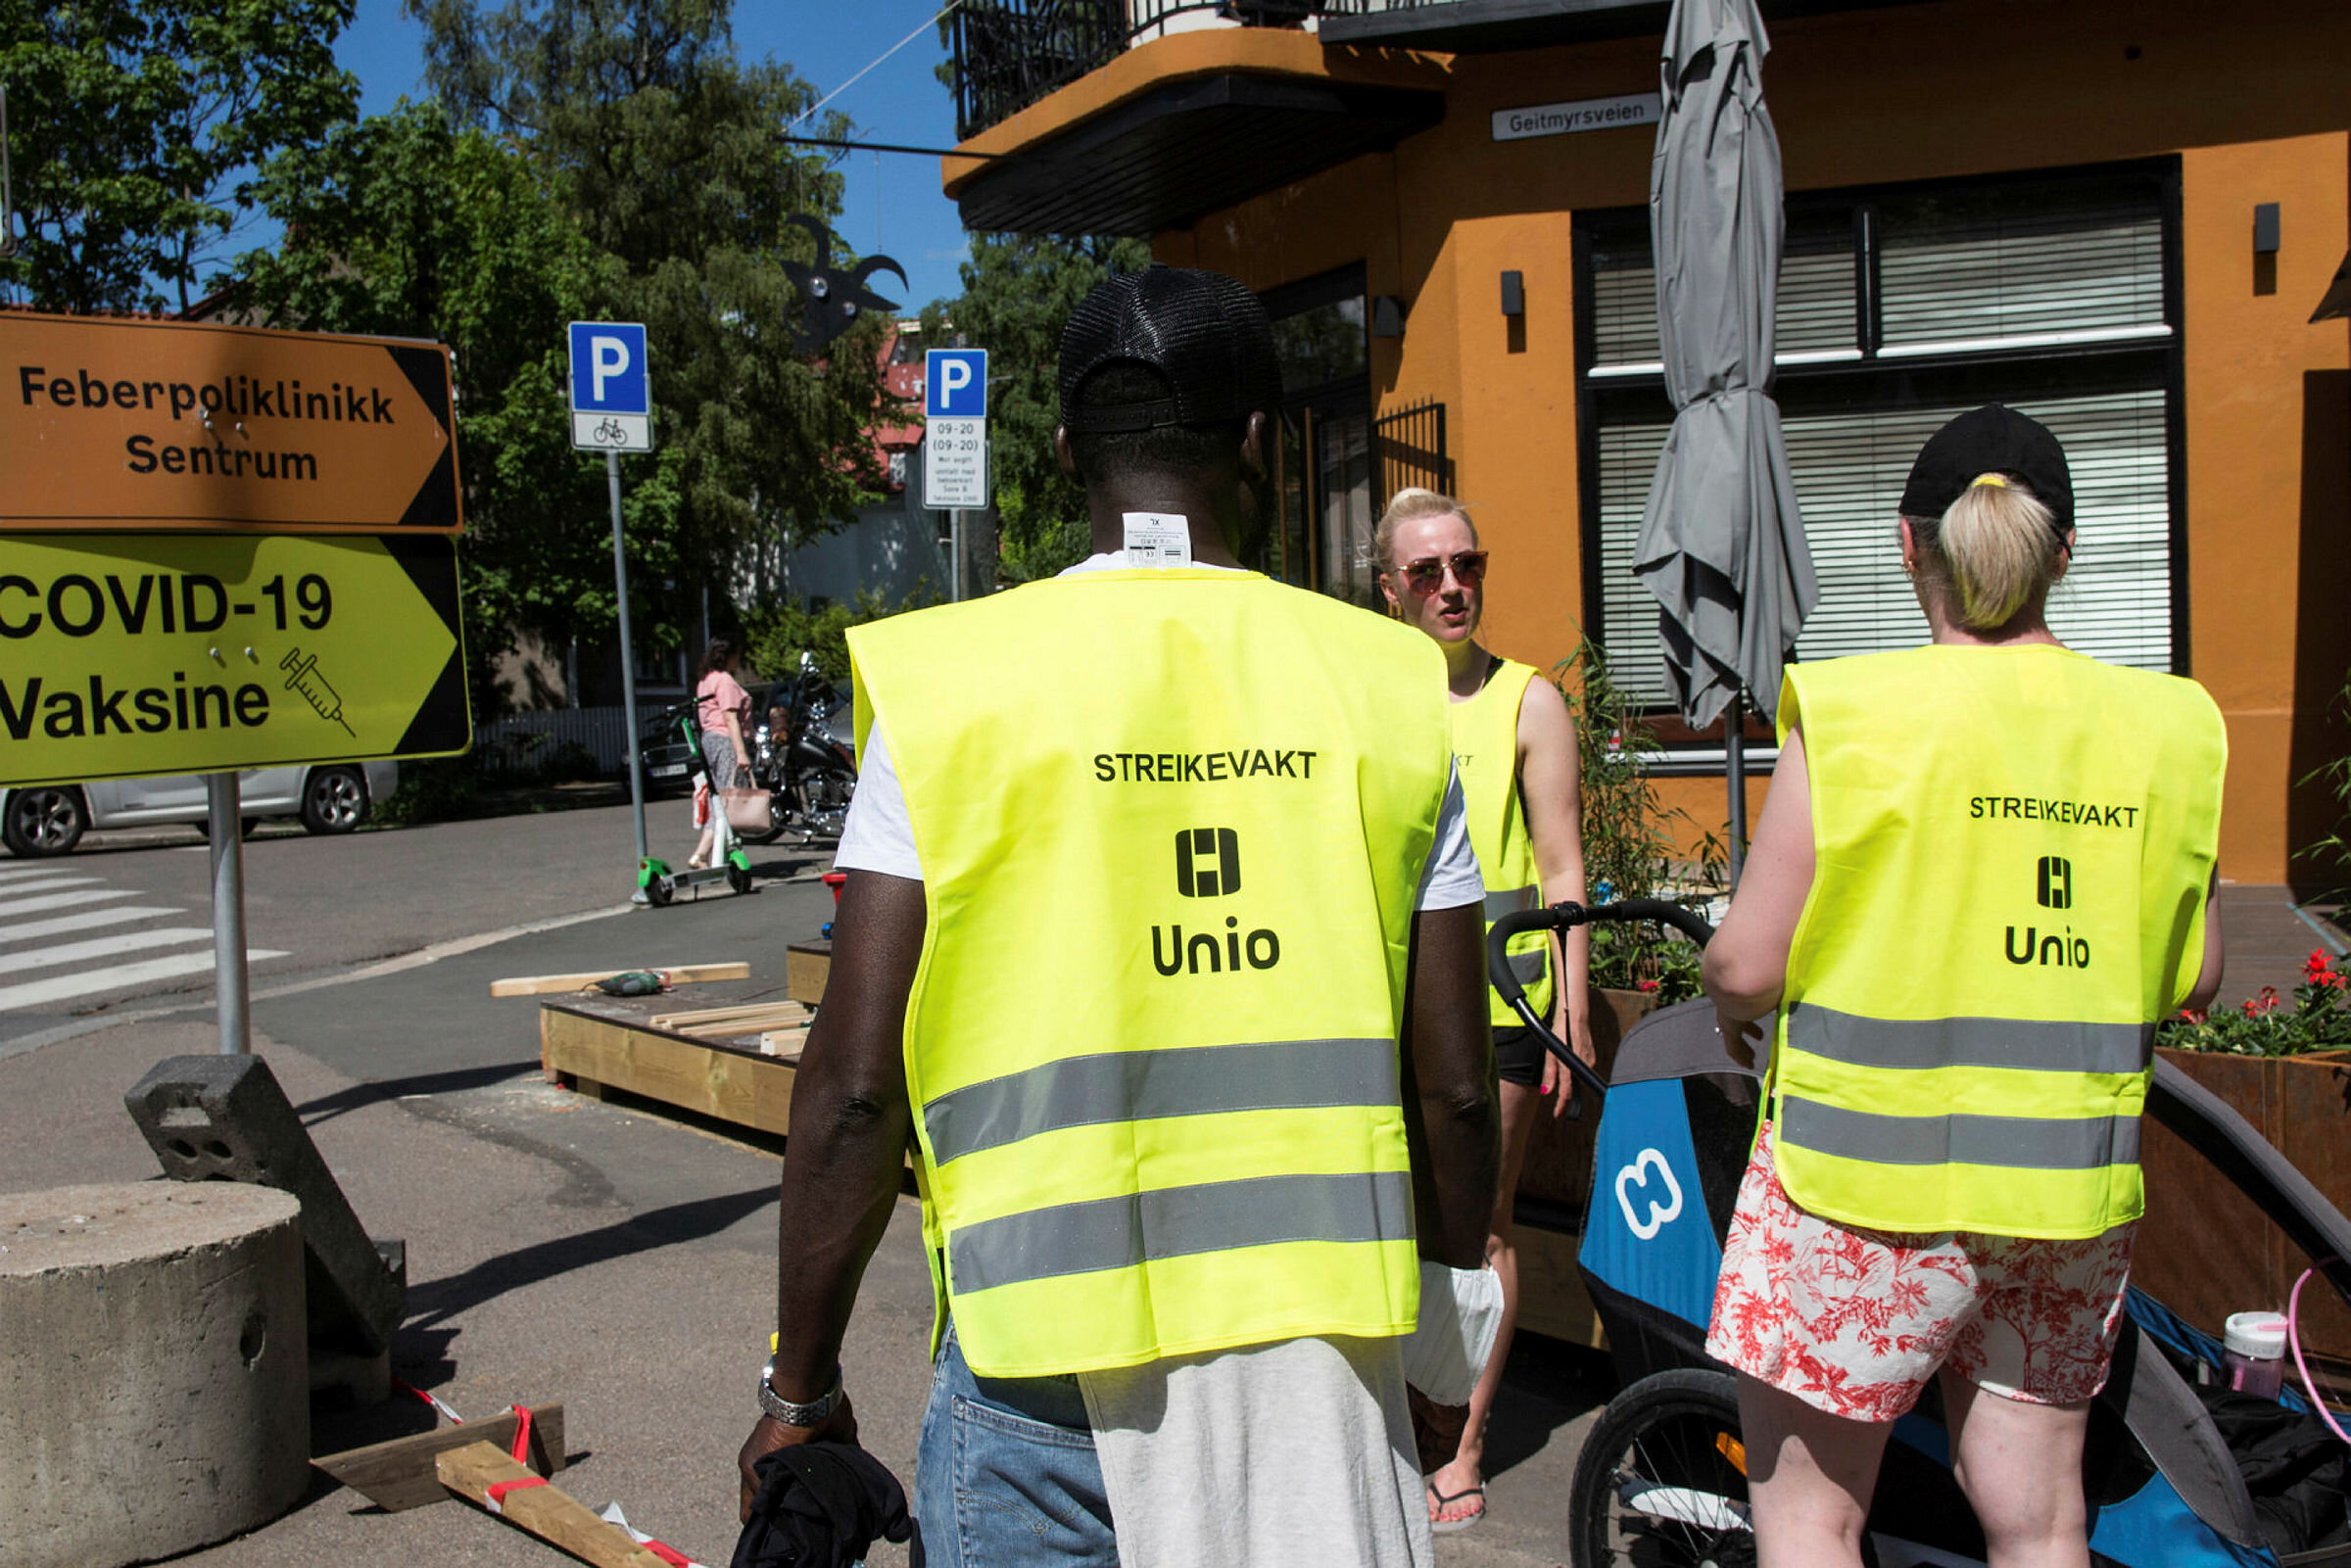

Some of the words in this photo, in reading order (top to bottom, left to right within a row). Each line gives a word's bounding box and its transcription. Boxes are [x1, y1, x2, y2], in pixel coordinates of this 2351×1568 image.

[1510, 103, 1644, 132] Geitmyrsveien
[591, 336, 630, 402] P
[940, 358, 973, 409] P
[19, 366, 395, 424] Feberpoliklinikk
[125, 435, 318, 481] Sentrum
[0, 573, 332, 639] COVID-19
[0, 672, 270, 740] Vaksine
[1093, 749, 1318, 783] STREIKEVAKT
[1970, 796, 2139, 829] STREIKEVAKT
[1151, 915, 1280, 976] Unio
[2005, 925, 2089, 969] Unio
